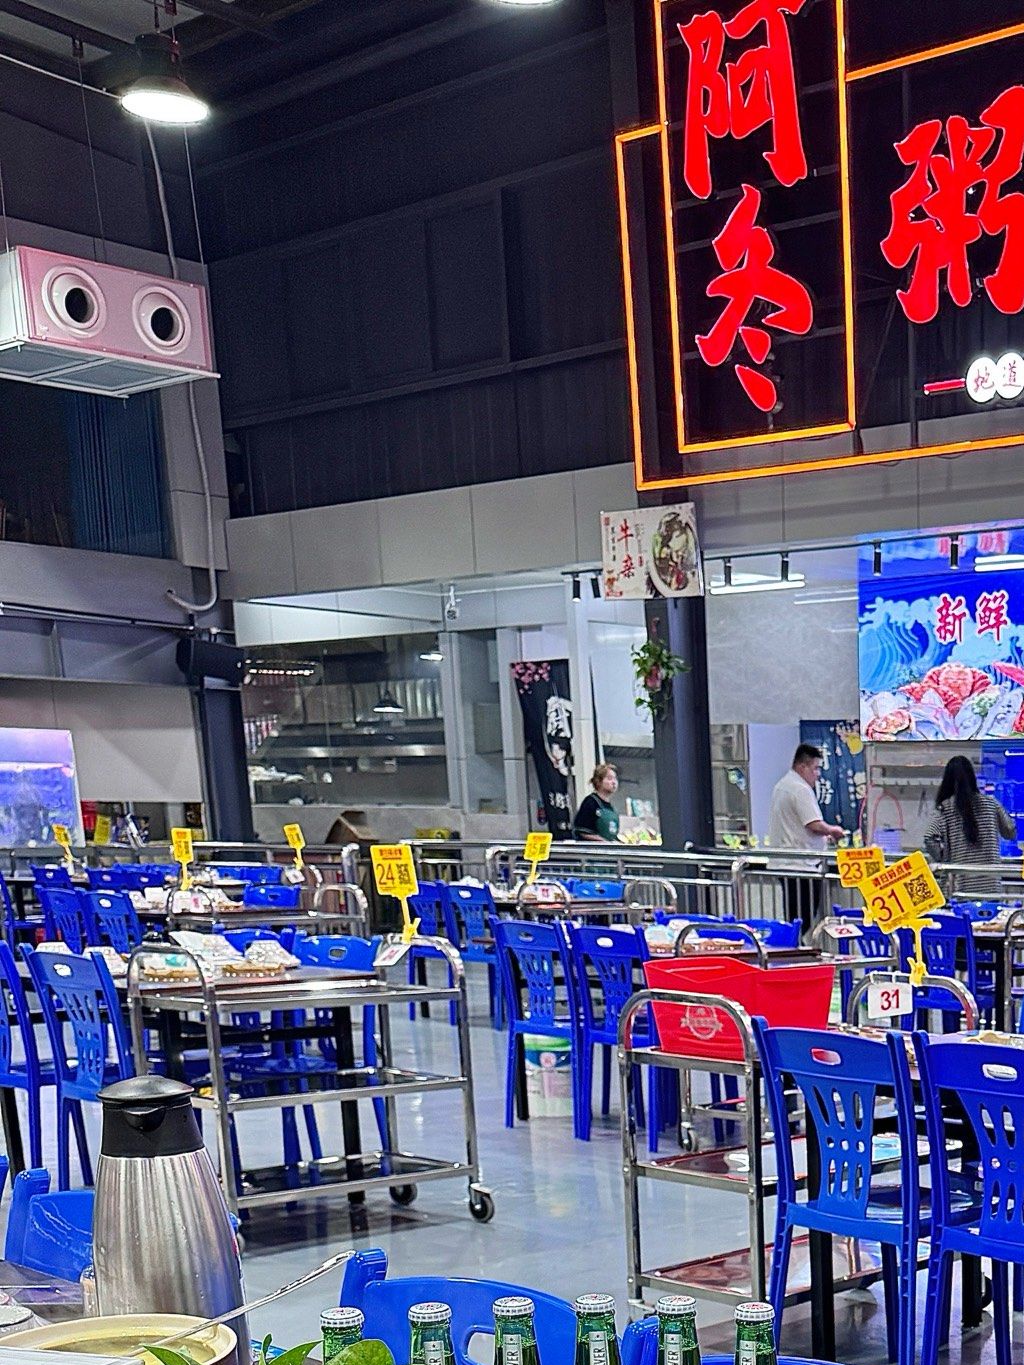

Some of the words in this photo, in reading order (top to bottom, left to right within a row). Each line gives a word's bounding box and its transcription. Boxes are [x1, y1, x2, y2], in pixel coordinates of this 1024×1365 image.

[677, 0, 813, 412] 阿冬
[935, 592, 1009, 643] 新鲜
[376, 863, 394, 886] 24
[840, 862, 863, 880] 23
[872, 889, 905, 922] 31
[880, 989, 900, 1011] 31
